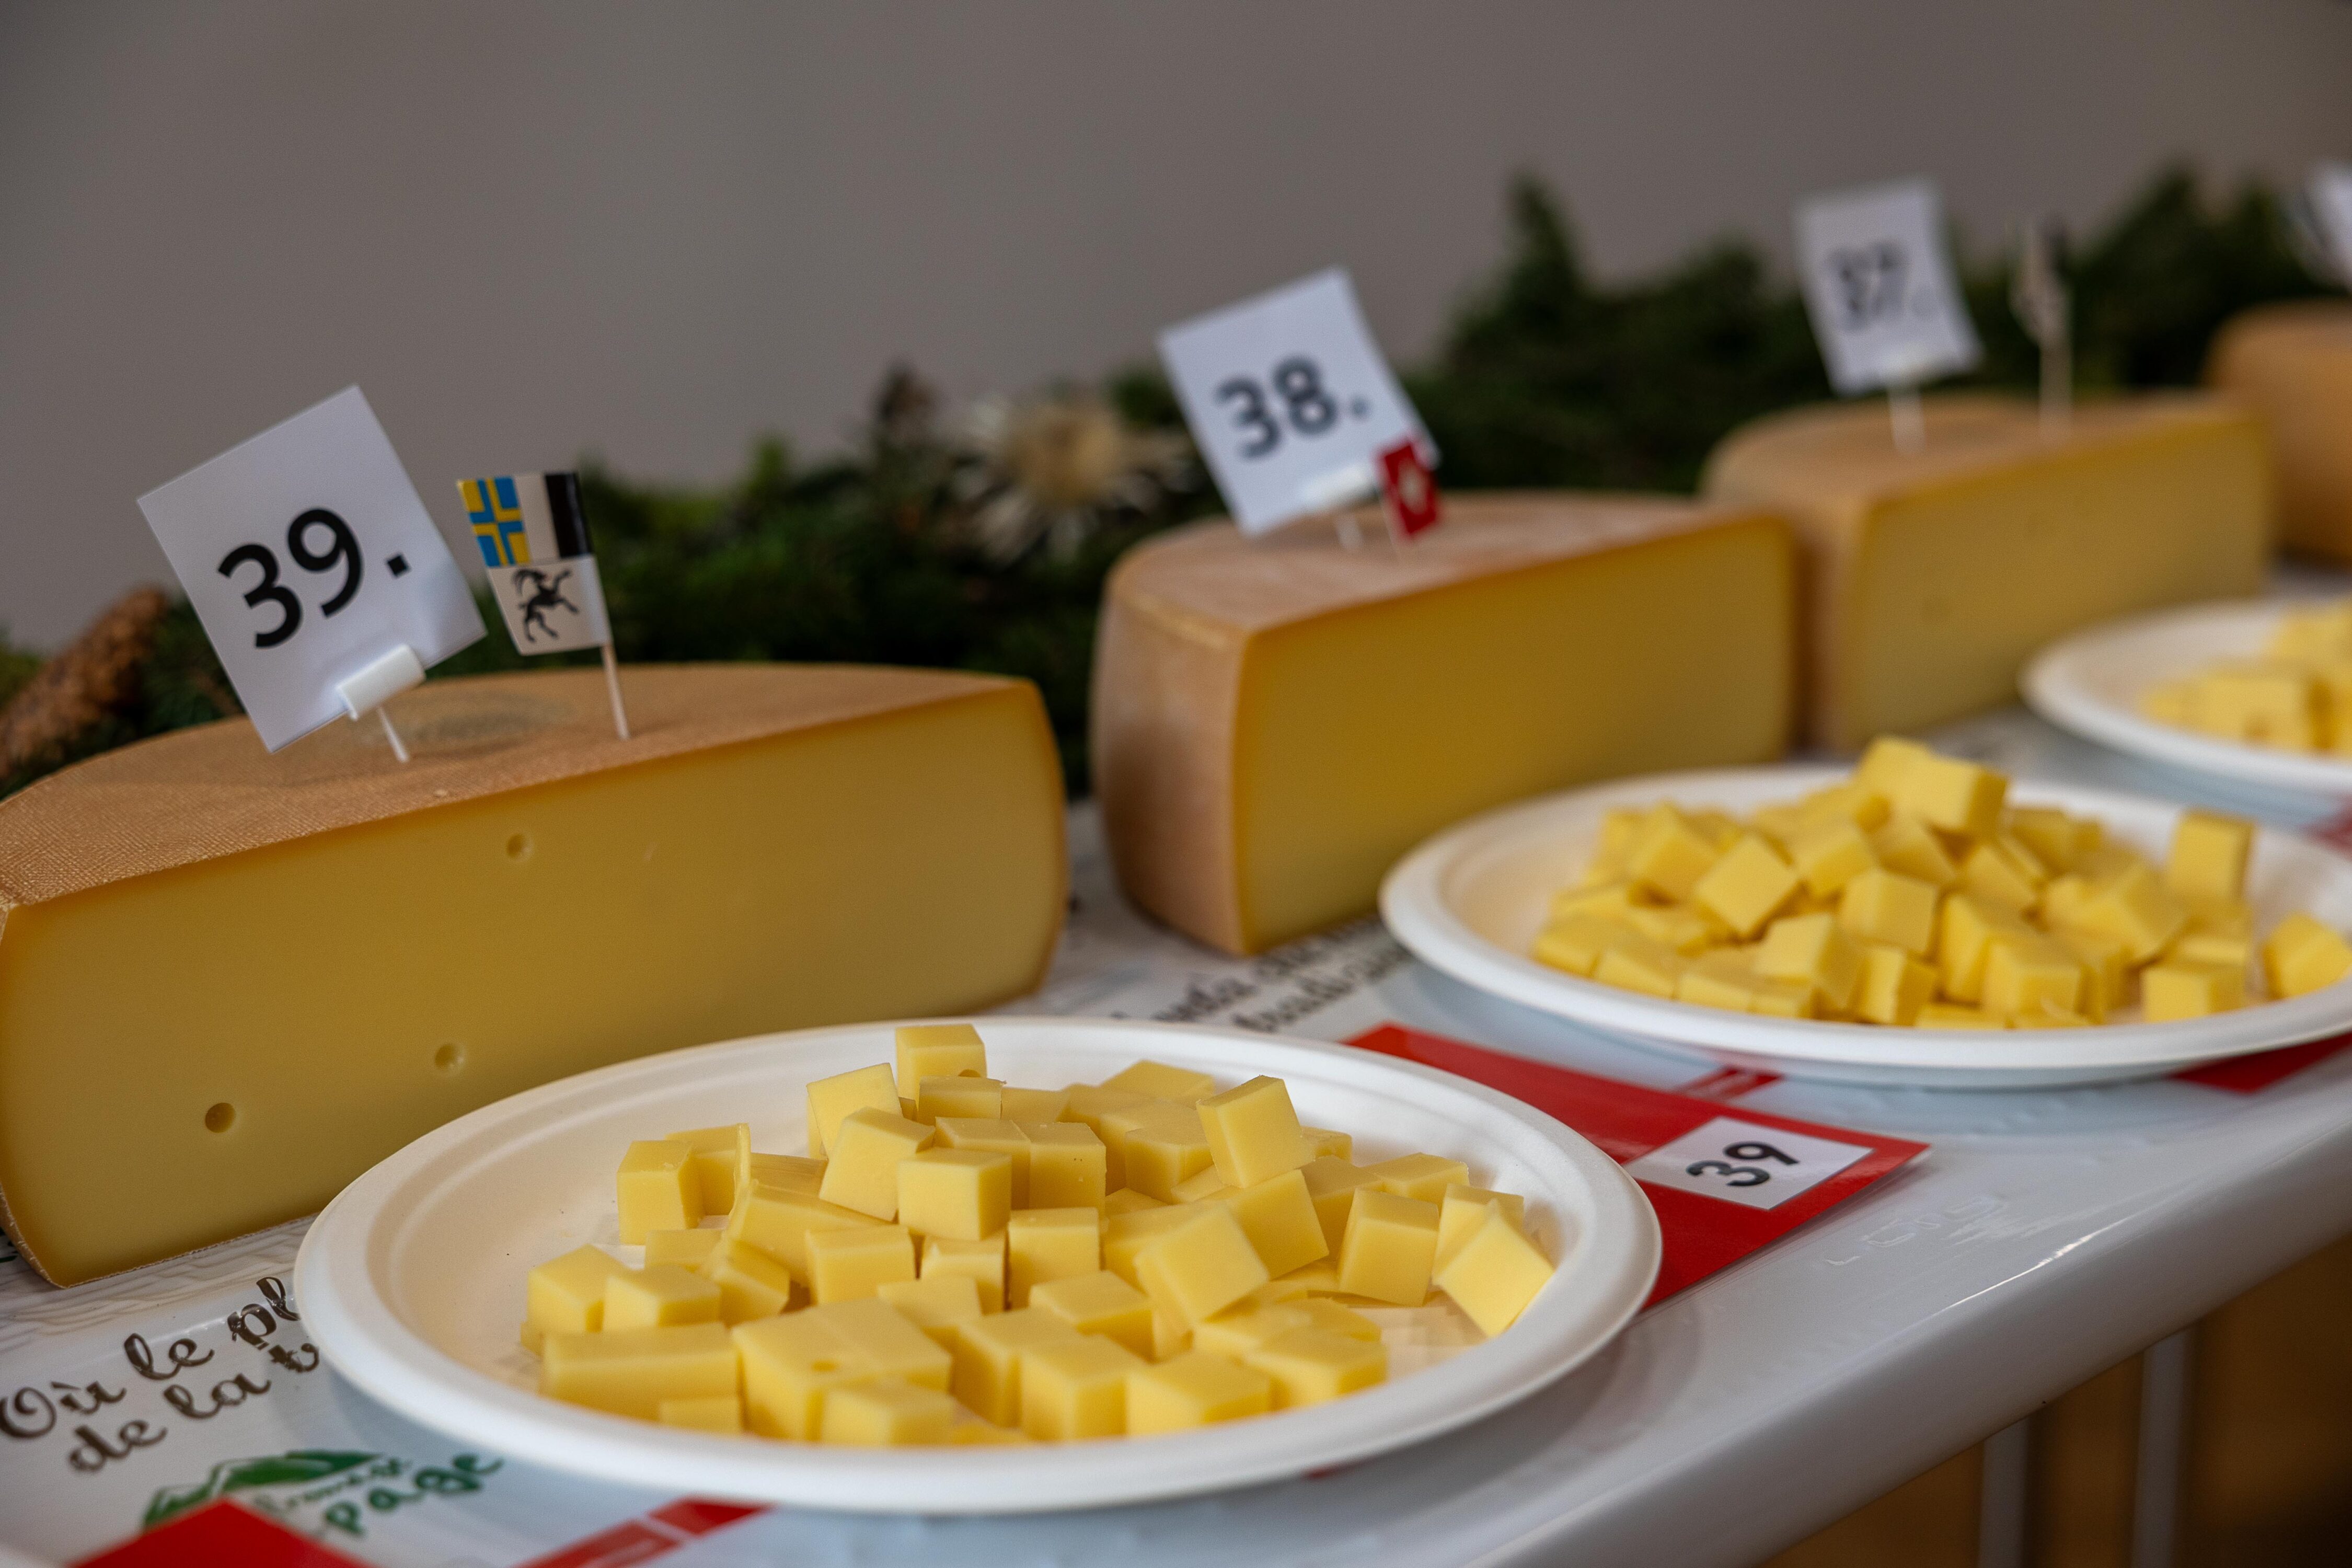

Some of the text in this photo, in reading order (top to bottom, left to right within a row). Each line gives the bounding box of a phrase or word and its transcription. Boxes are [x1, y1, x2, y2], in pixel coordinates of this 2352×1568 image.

[1214, 353, 1370, 461] 38.
[216, 507, 413, 649] 39.
[1685, 1140, 1800, 1187] 39
[0, 1276, 301, 1440] Où le pl
[67, 1342, 319, 1473] de la t
[321, 1453, 504, 1538] page
